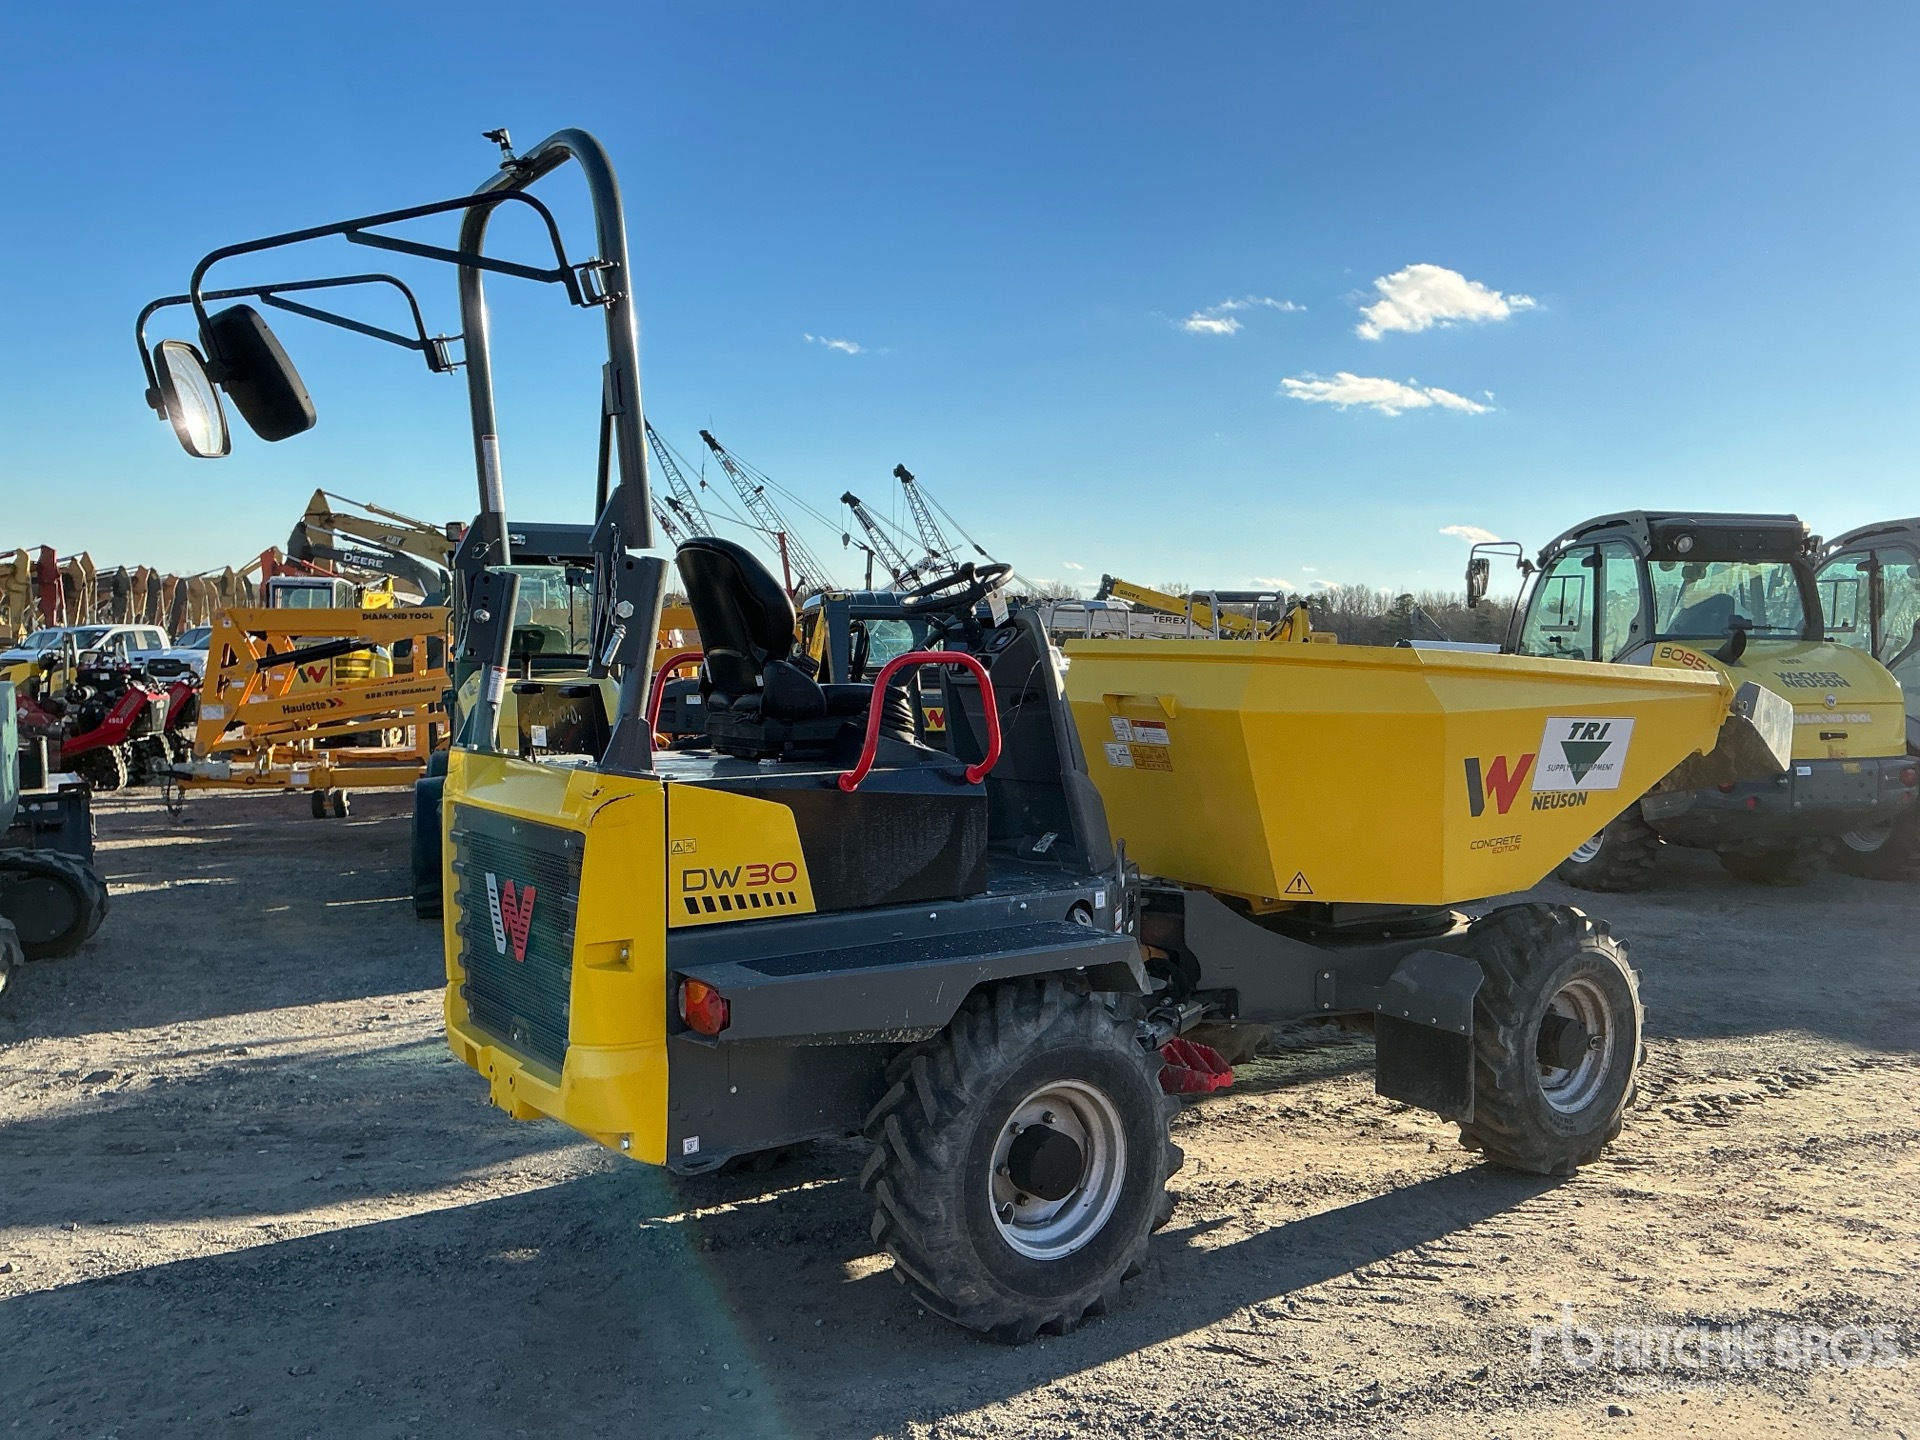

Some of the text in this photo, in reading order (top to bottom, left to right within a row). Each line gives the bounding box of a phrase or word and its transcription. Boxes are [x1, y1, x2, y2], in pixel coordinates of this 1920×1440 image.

[386, 535, 402, 545] CAT
[343, 552, 384, 568] DEERE
[1119, 590, 1141, 599] GROVE
[1153, 615, 1187, 625] TEREX
[1773, 672, 1845, 680] WACKER
[1782, 679, 1852, 688] NEUSON
[282, 700, 327, 714] Haulotte
[1846, 713, 1872, 722] TOOL
[1568, 722, 1611, 740] TRI
[1547, 764, 1571, 772] SUPPLY
[1531, 792, 1588, 811] NEUSON
[1470, 835, 1522, 850] CONCRETE
[1492, 844, 1521, 854] EDITION
[683, 862, 798, 892] DW30
